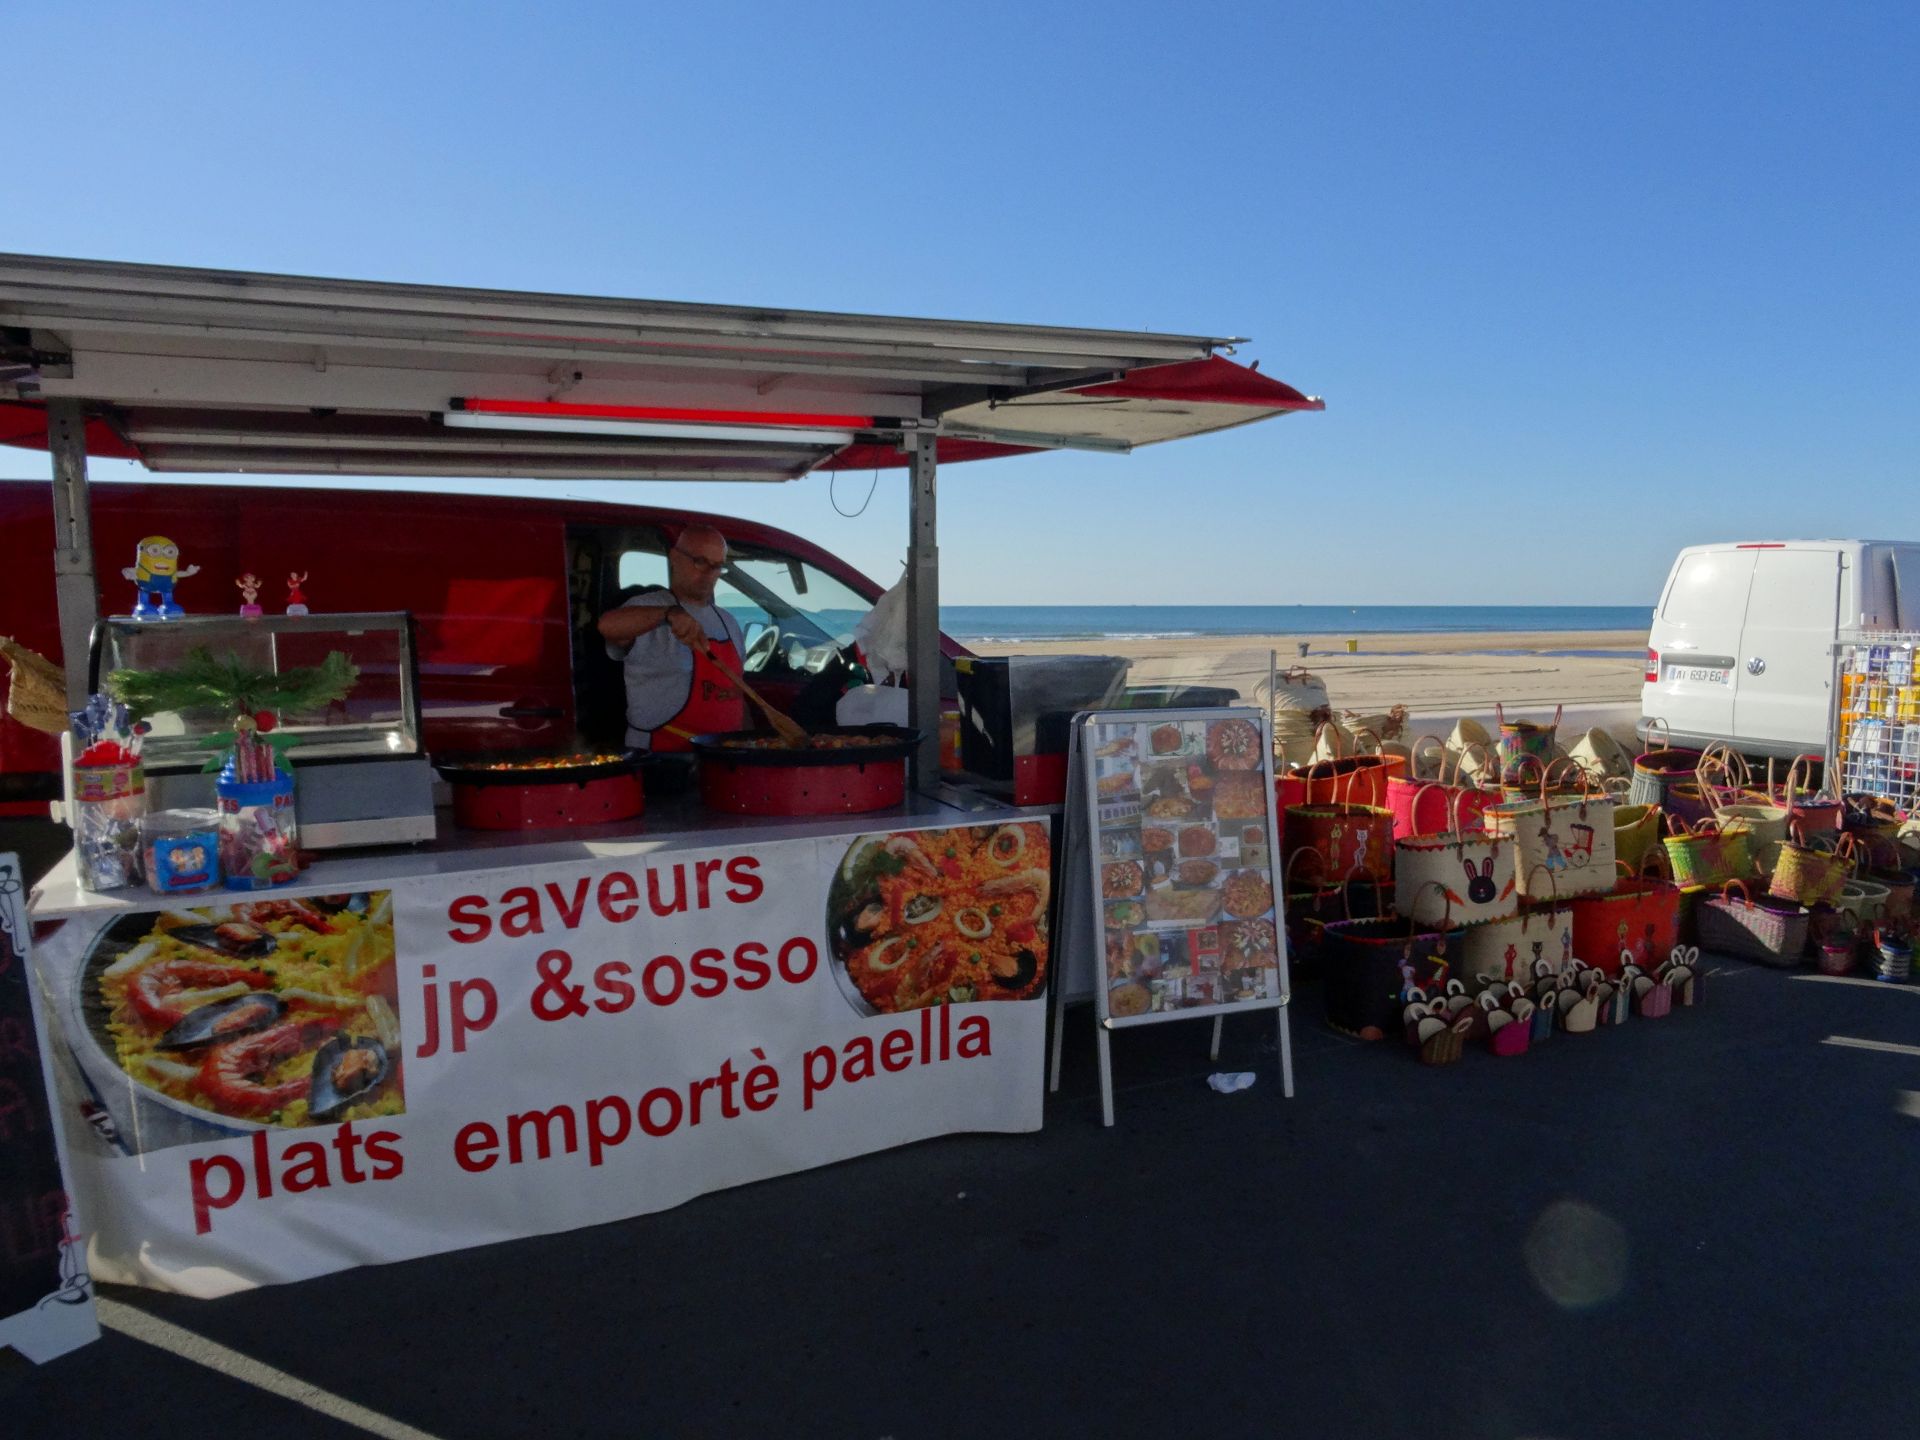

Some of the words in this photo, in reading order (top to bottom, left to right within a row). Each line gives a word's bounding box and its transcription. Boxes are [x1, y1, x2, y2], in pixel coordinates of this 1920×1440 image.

[448, 856, 763, 943] saveurs
[416, 963, 497, 1058] jp
[189, 1120, 404, 1235] plats
[454, 1048, 779, 1172] emportè
[802, 1003, 991, 1110] paella
